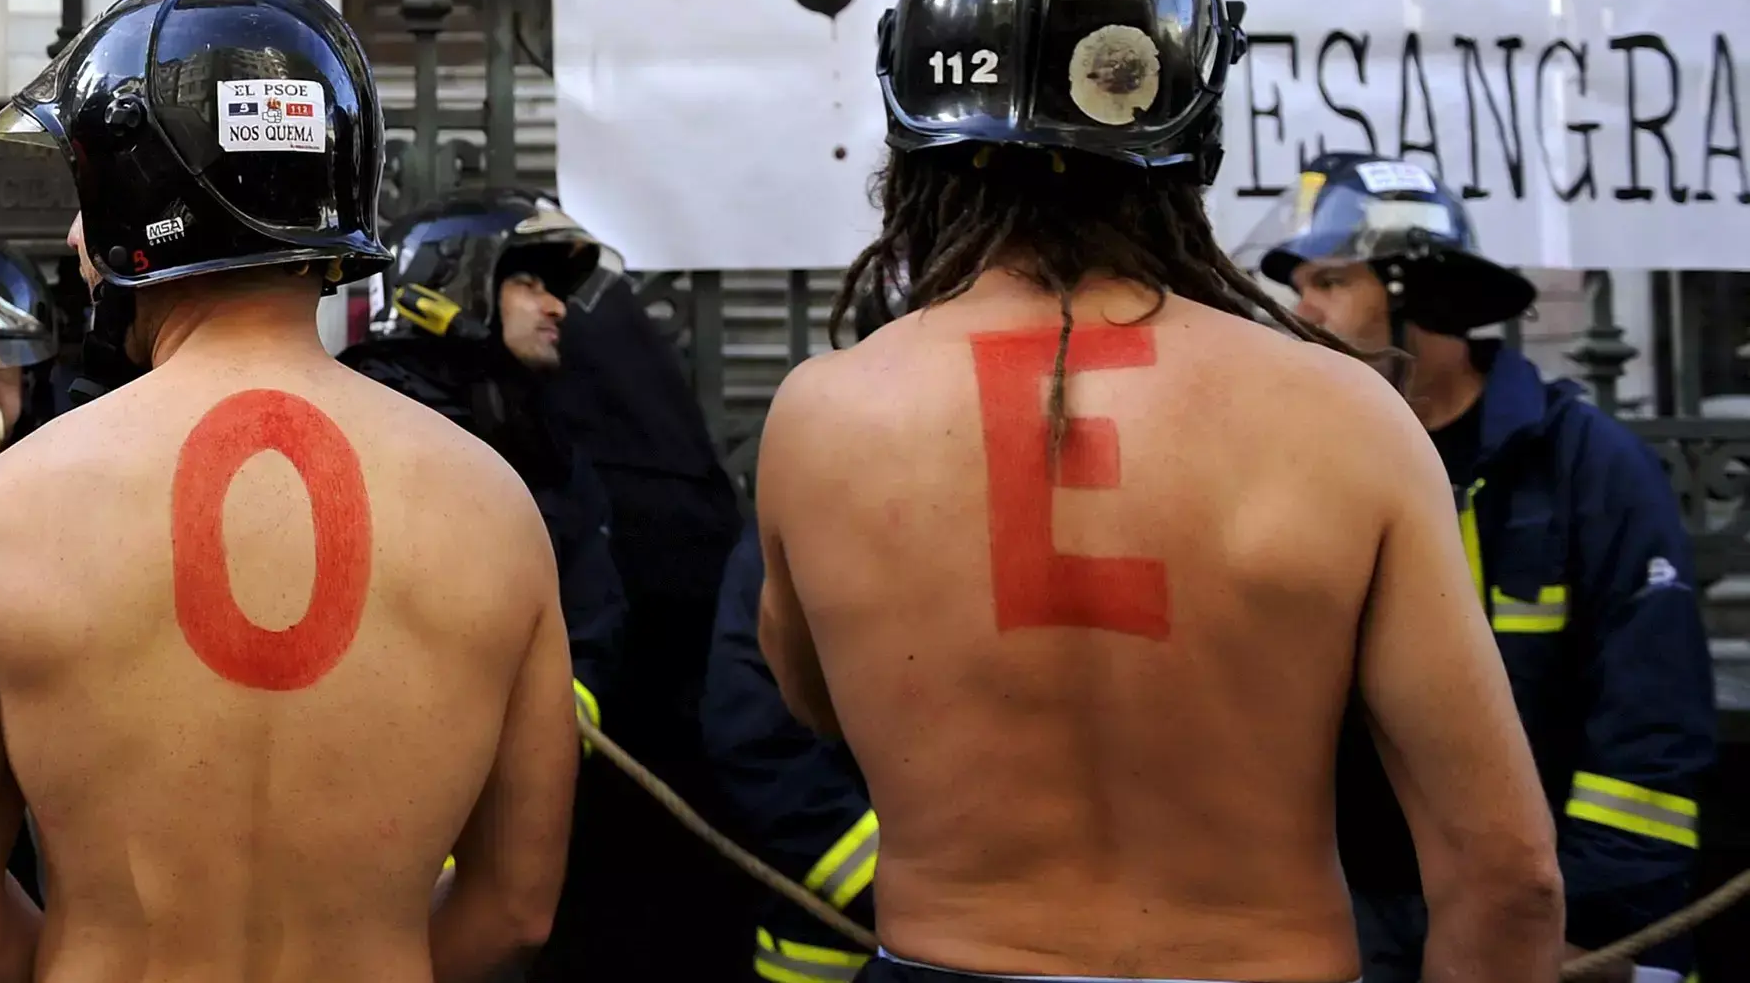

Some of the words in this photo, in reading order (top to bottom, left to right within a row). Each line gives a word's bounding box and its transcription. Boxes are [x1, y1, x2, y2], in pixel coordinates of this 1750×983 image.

[928, 49, 999, 84] 112
[234, 84, 255, 96] EL
[264, 84, 308, 97] PSOE
[290, 105, 308, 114] 112
[230, 125, 259, 141] NOS
[265, 125, 314, 142] QUEMA
[148, 219, 182, 238] MSA
[170, 388, 373, 692] O
[969, 325, 1171, 642] E
